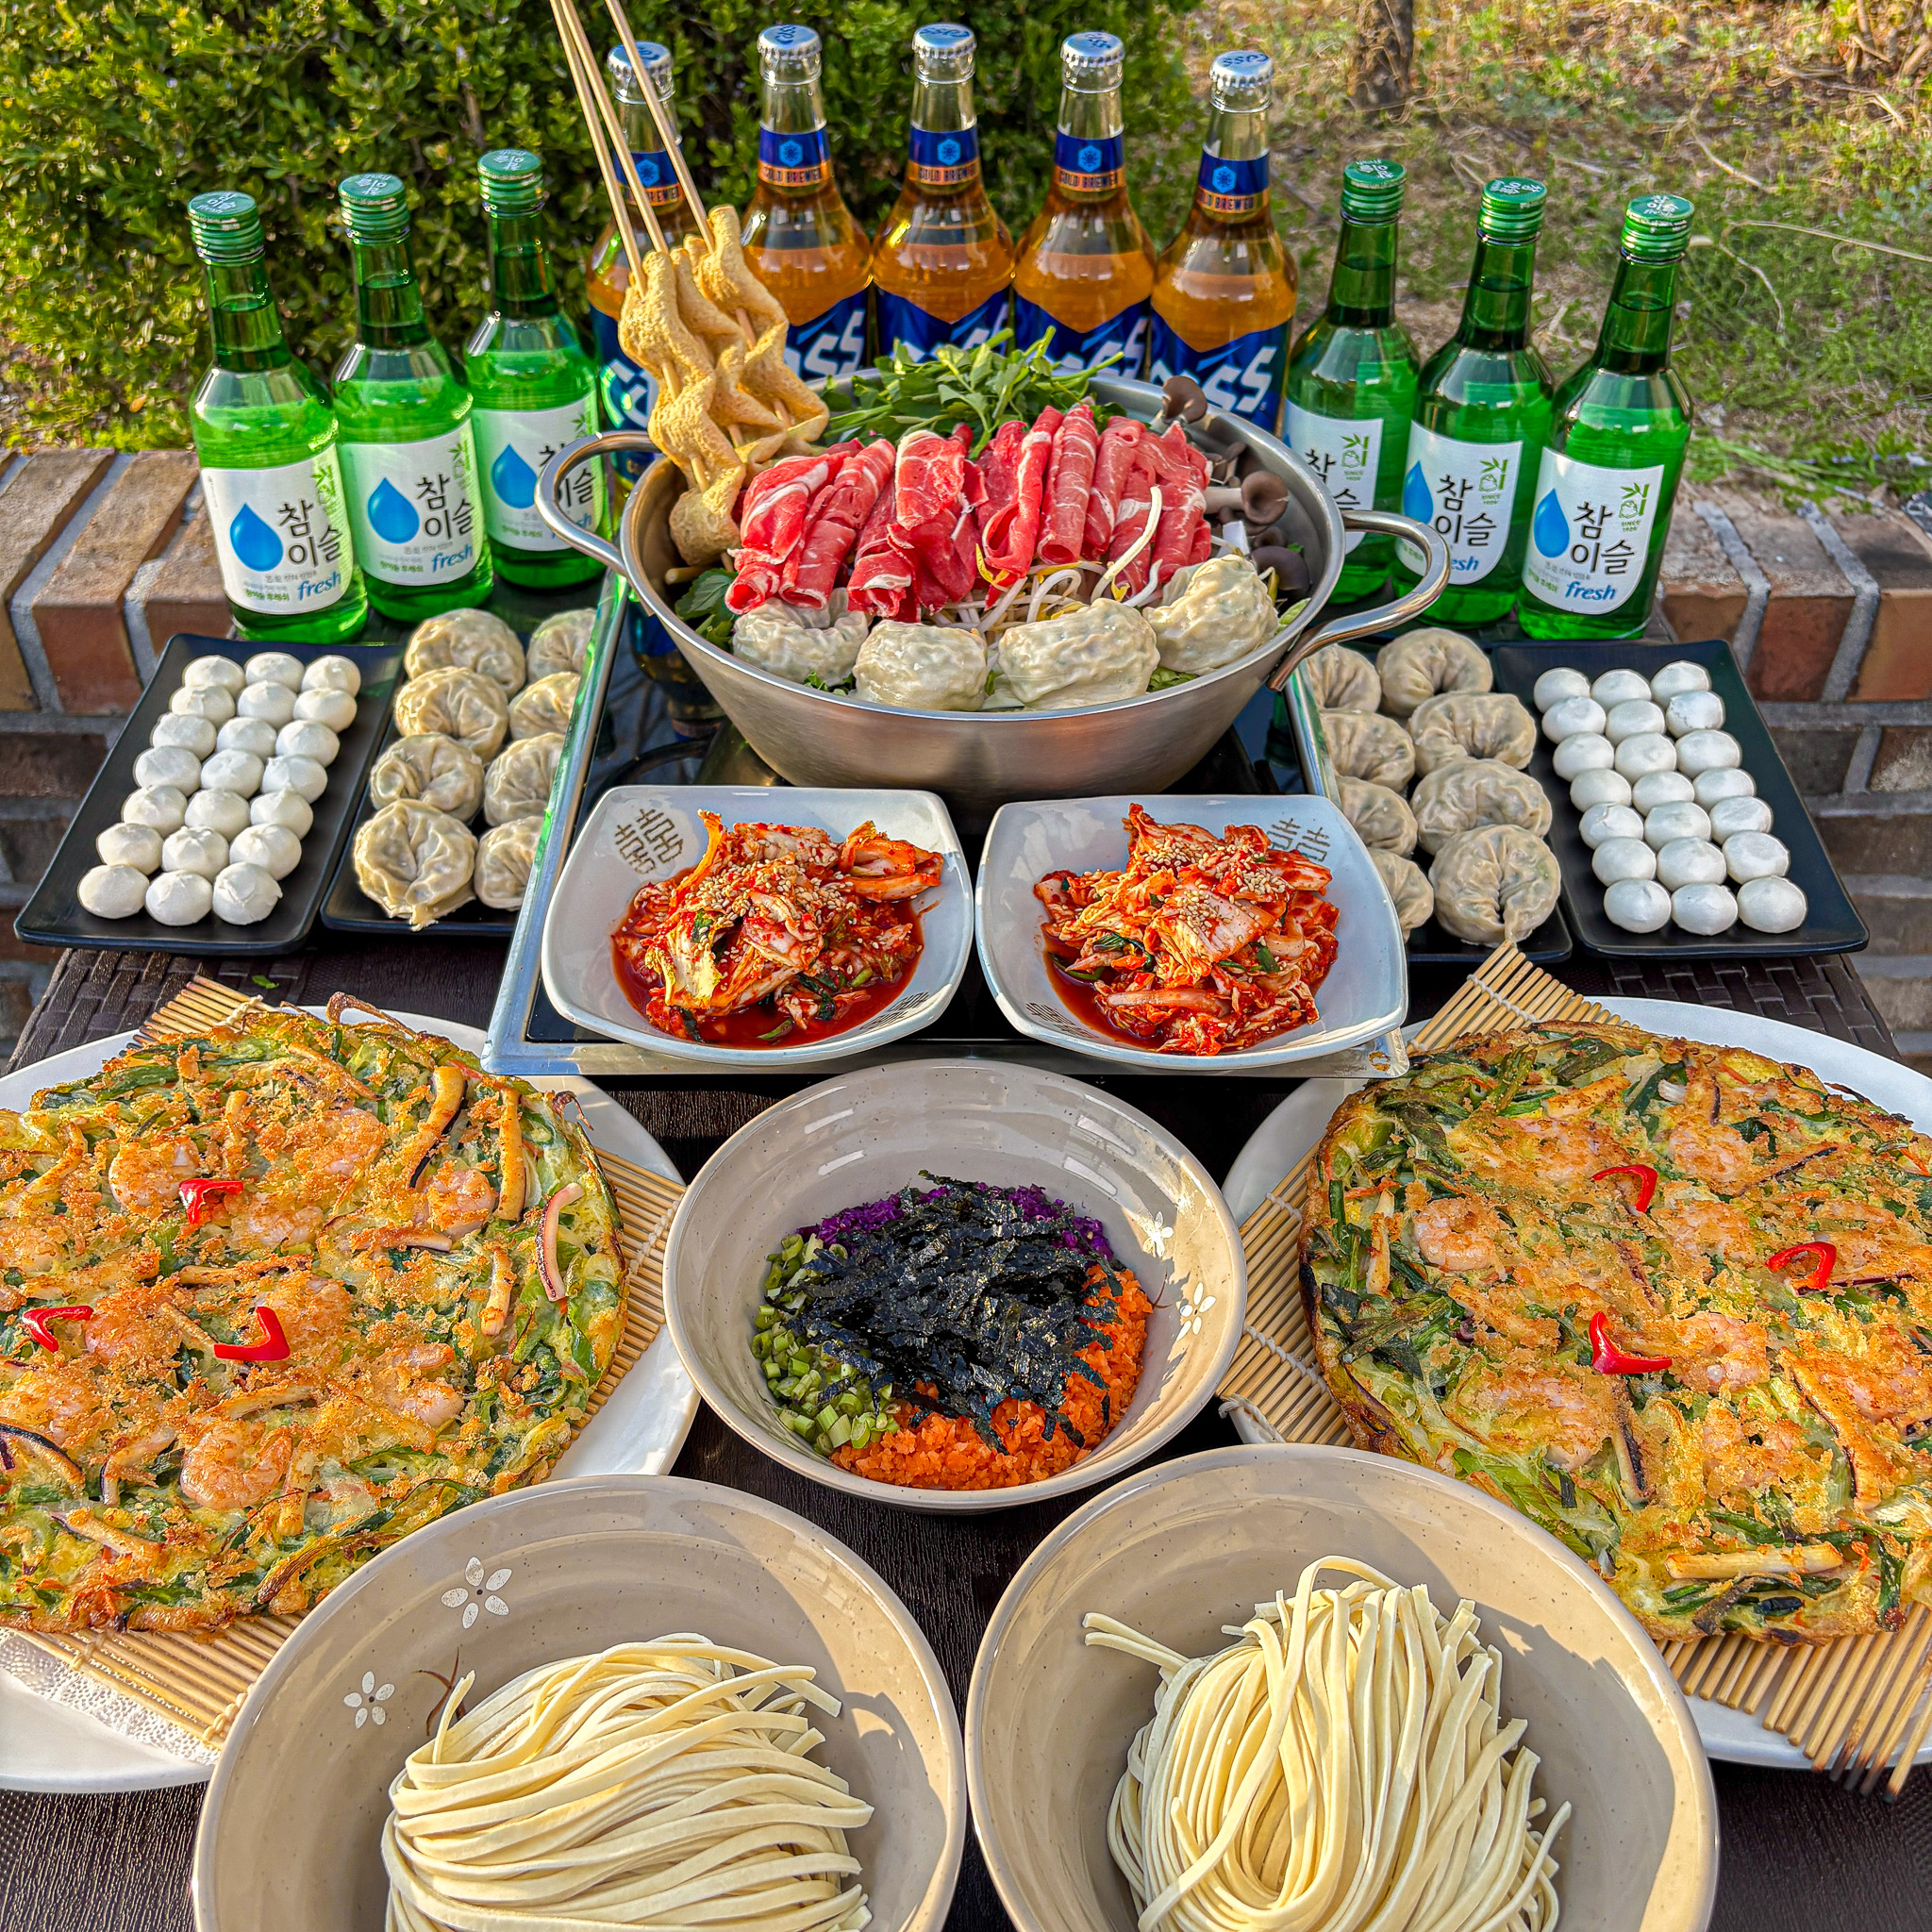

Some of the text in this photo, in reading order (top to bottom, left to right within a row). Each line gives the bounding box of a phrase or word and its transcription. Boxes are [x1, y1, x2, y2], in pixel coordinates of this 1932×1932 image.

[424, 498, 475, 541] 이슬
[1434, 512, 1497, 547] 이슬
[288, 525, 343, 568] 이슬
[431, 544, 473, 574] fresh
[1570, 539, 1635, 575] 이슬
[1450, 556, 1479, 571] esh
[297, 570, 341, 600] fresh
[1564, 580, 1617, 601] fresh
